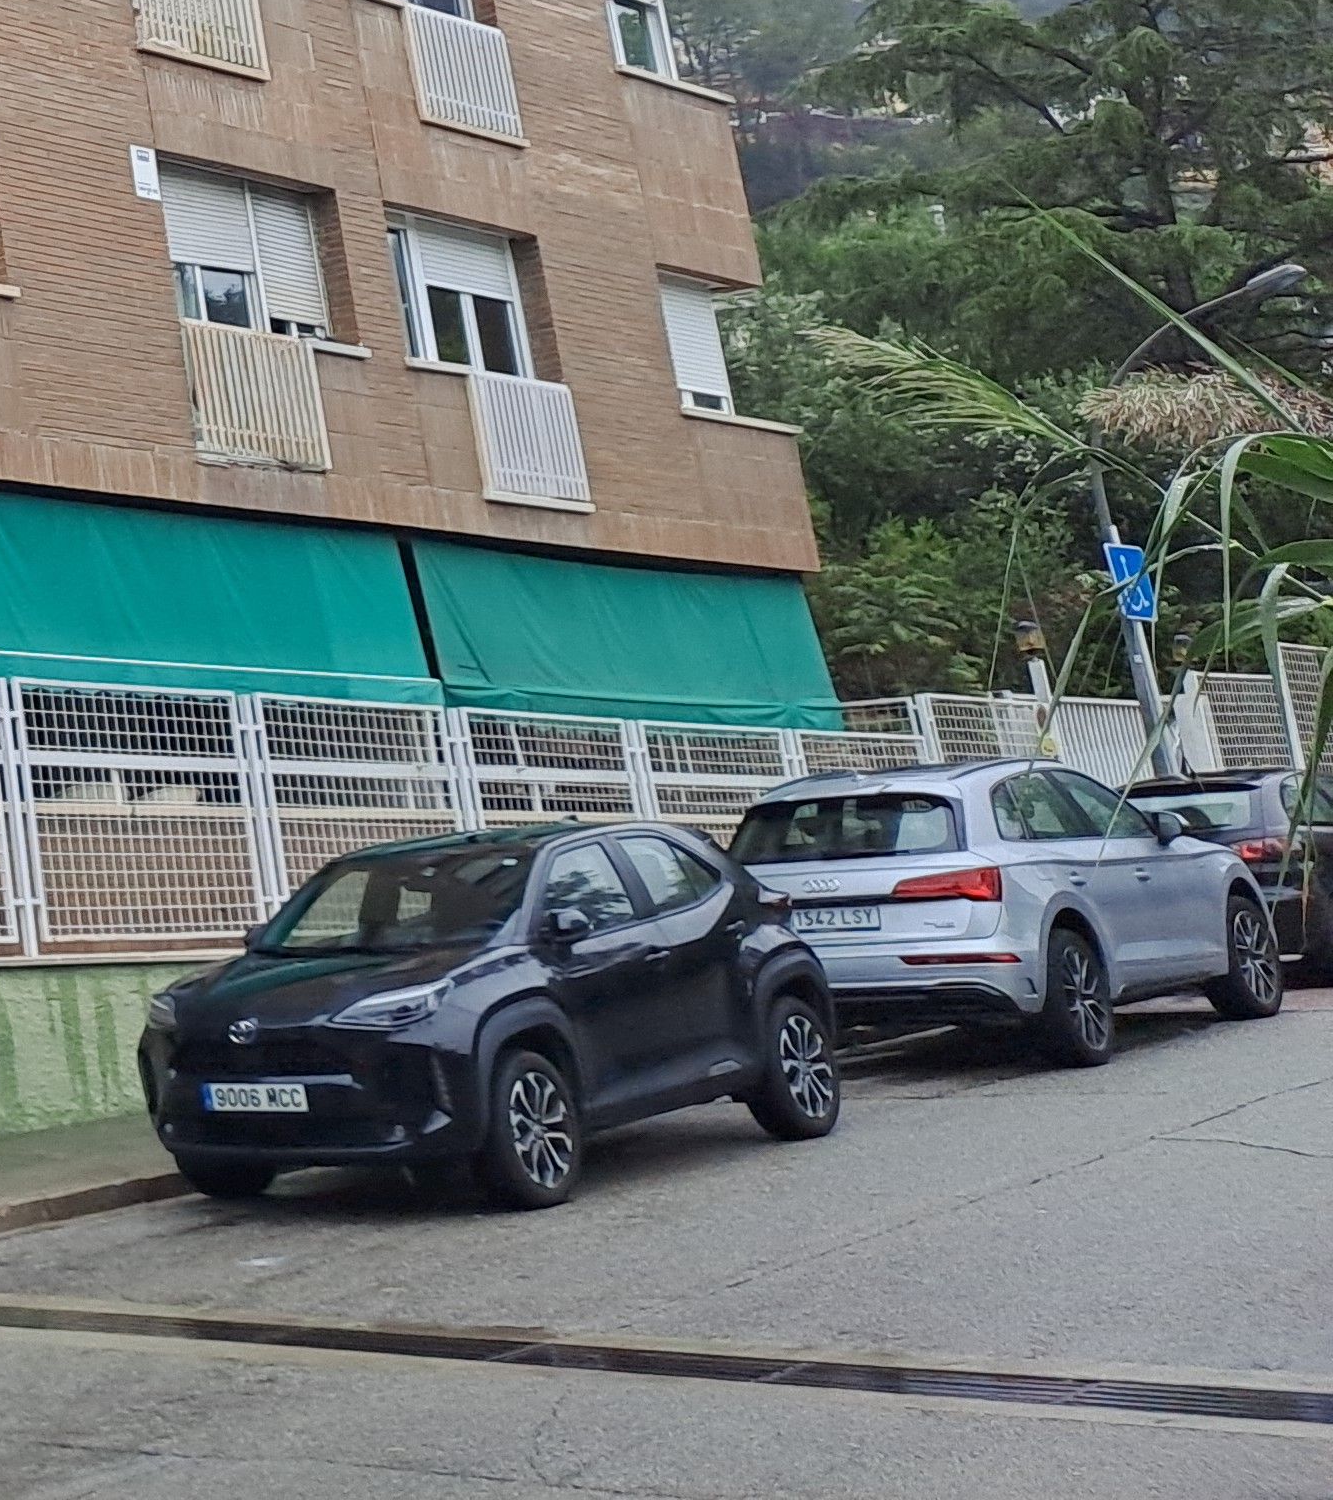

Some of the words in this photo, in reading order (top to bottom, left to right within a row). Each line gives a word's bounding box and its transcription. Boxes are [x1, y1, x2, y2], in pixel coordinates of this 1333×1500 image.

[796, 910, 837, 927] 1542
[841, 908, 874, 926] LSY
[214, 1087, 262, 1108] 9006
